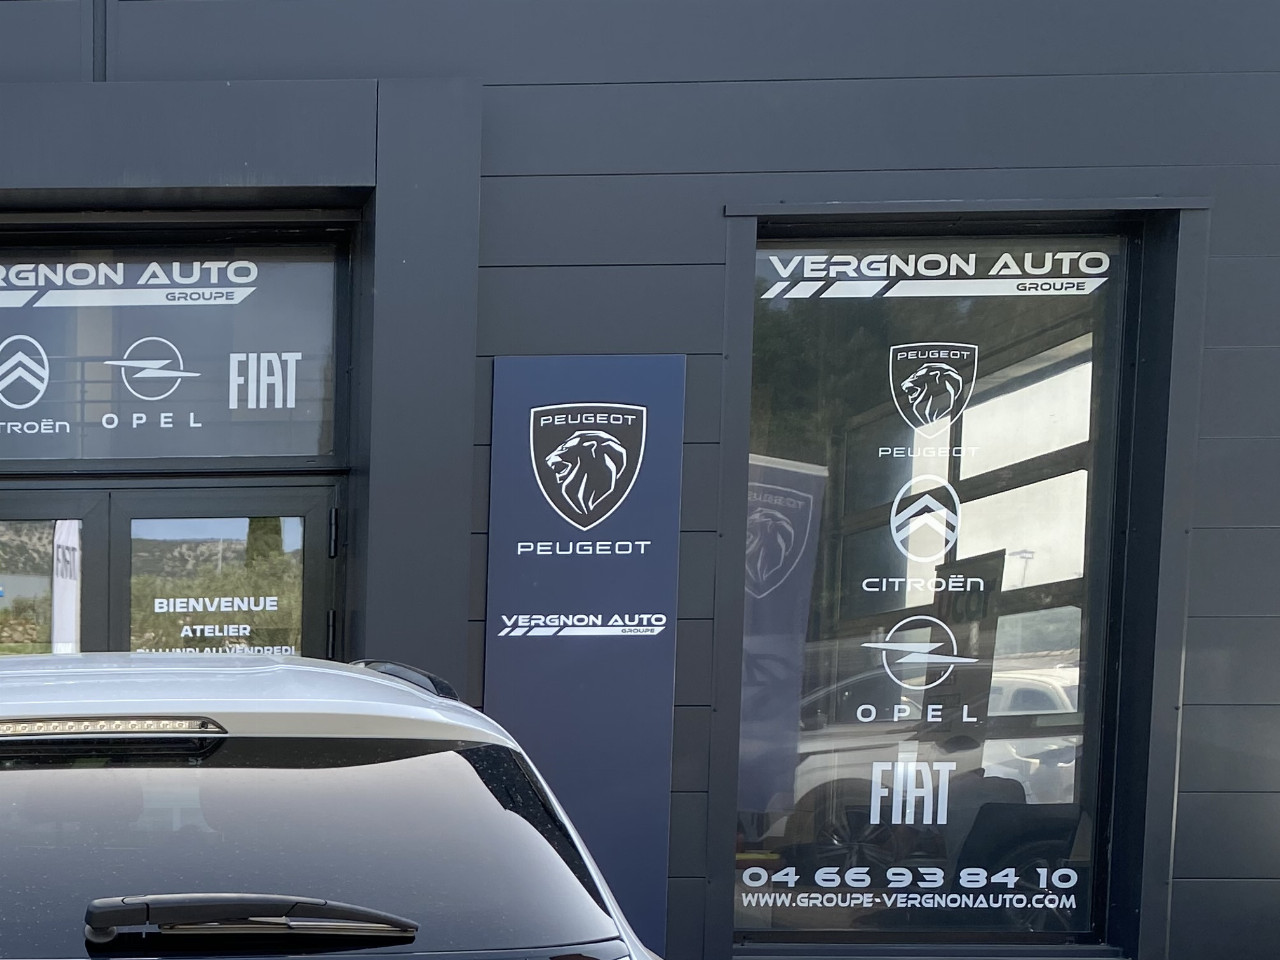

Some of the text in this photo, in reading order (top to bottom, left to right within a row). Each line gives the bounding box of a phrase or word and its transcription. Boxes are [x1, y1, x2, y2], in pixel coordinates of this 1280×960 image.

[136, 260, 258, 285] AUTO
[768, 251, 1110, 278] VERGNON AUTO
[1016, 281, 1087, 292] GROUPE
[165, 290, 236, 301] GROUPE
[896, 350, 971, 361] PEUGEOT
[228, 351, 303, 410] FIAT
[101, 412, 203, 429] OPEL
[540, 413, 637, 427] PEUGEOT
[878, 446, 981, 458] PEUGEOT
[517, 540, 652, 556] PEUGEOT
[154, 596, 279, 613] BIENVENUE
[501, 613, 667, 627] VERGNON AUTO
[180, 624, 251, 638] ATELIER
[621, 627, 656, 635] GROUPE
[856, 704, 978, 723] OPEL
[869, 761, 957, 825] FIAT
[742, 866, 1078, 889] 04 66 93 84 10
[741, 892, 1077, 909] WWW.GROUPE-VERGNONAUTO.COM
